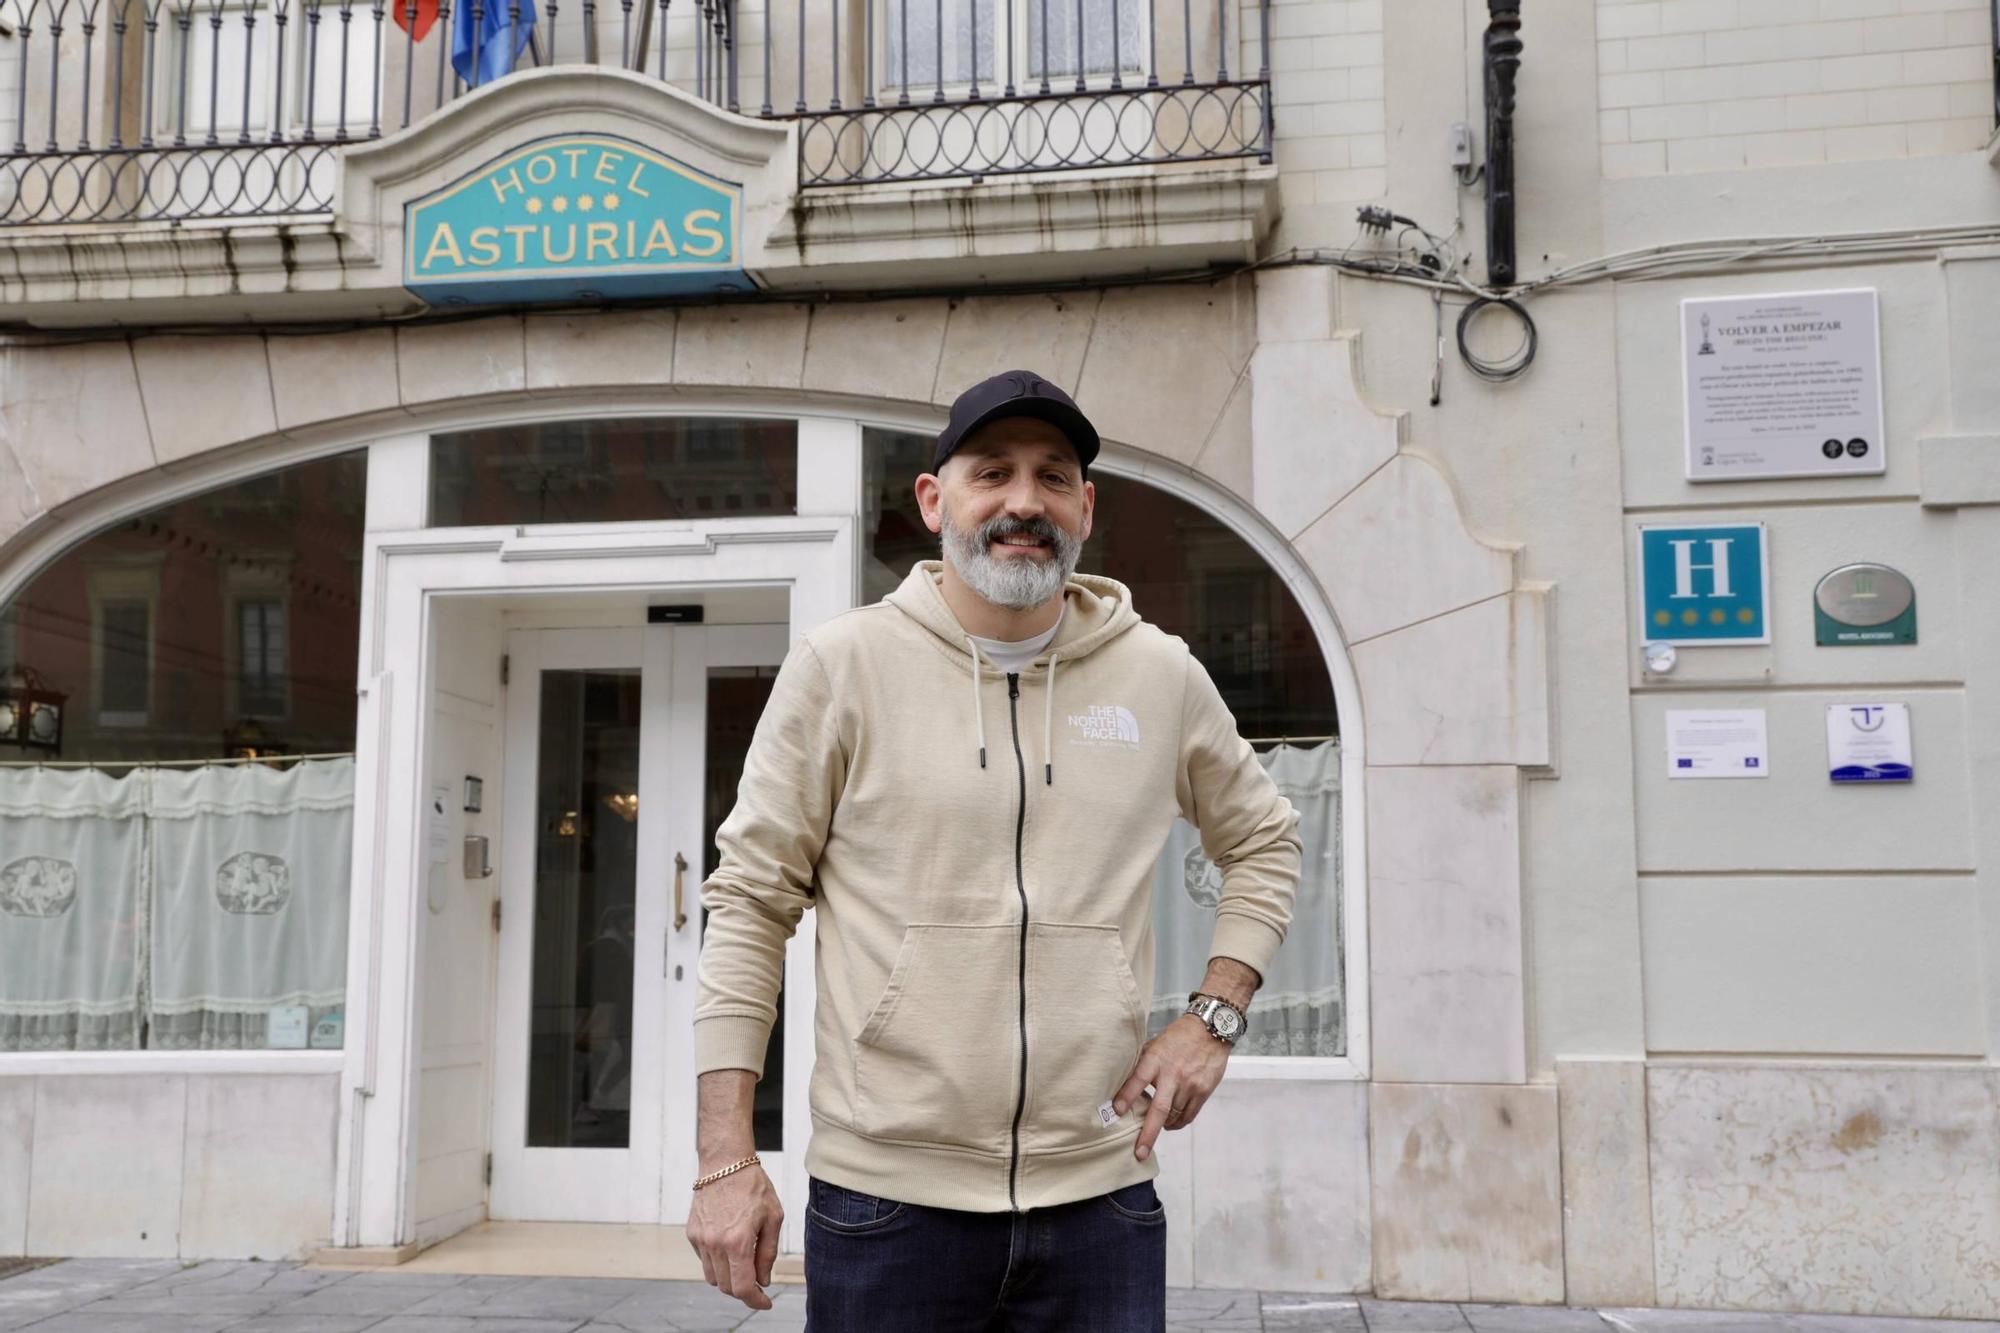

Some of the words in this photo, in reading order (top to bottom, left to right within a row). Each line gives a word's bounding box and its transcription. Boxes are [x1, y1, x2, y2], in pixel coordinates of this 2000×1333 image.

[489, 148, 650, 204] HOTEL
[420, 208, 725, 270] ASTURIAS
[1718, 324, 1769, 337] VOLVER
[1771, 323, 1781, 334] A
[1783, 320, 1842, 333] EMPEZAR
[1668, 538, 1737, 599] H
[1088, 704, 1116, 719] THE
[1067, 714, 1119, 730] NORTH
[1083, 727, 1117, 740] FACE
